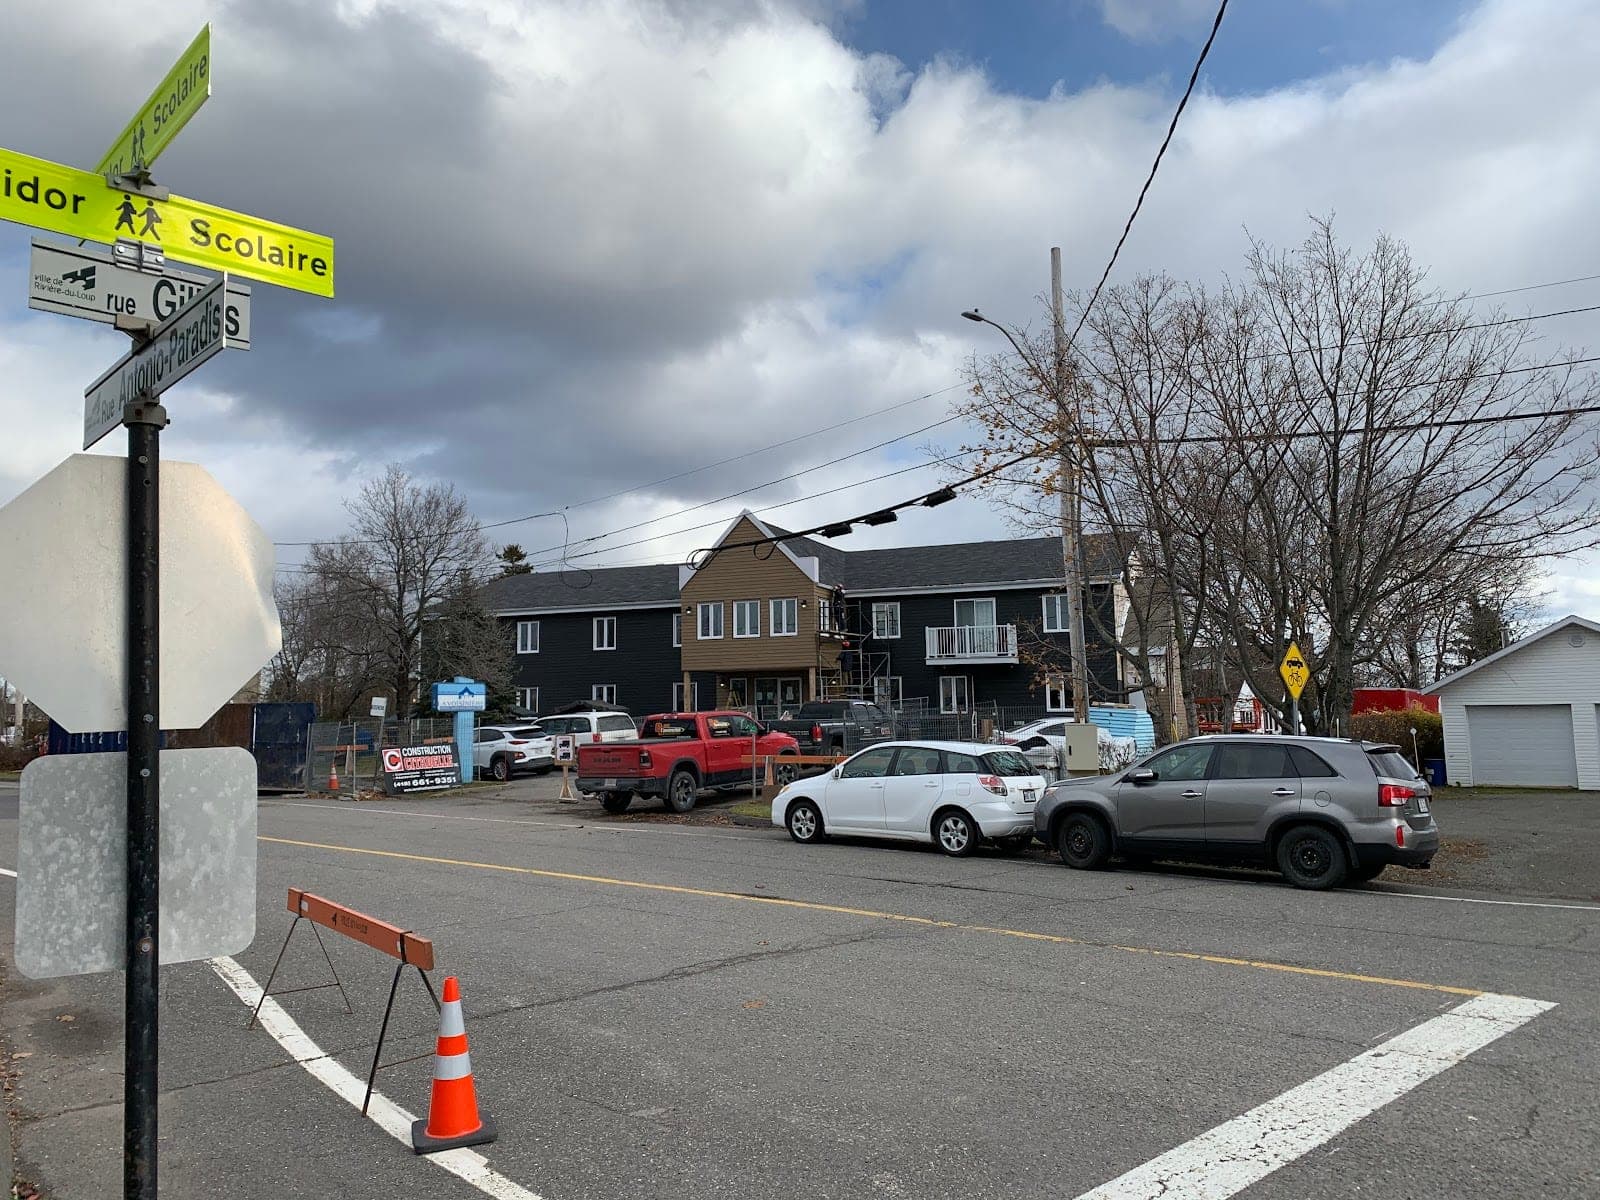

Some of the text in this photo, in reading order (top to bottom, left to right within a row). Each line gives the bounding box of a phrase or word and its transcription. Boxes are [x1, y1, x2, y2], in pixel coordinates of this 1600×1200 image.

[153, 55, 207, 134] Scolaire
[190, 218, 327, 276] Scolaire
[34, 274, 63, 286] ville de
[107, 292, 136, 314] rue
[118, 298, 221, 412] Antonio-Paradis
[402, 745, 452, 757] CONSTRUCTION
[412, 776, 457, 787] 661-9351
